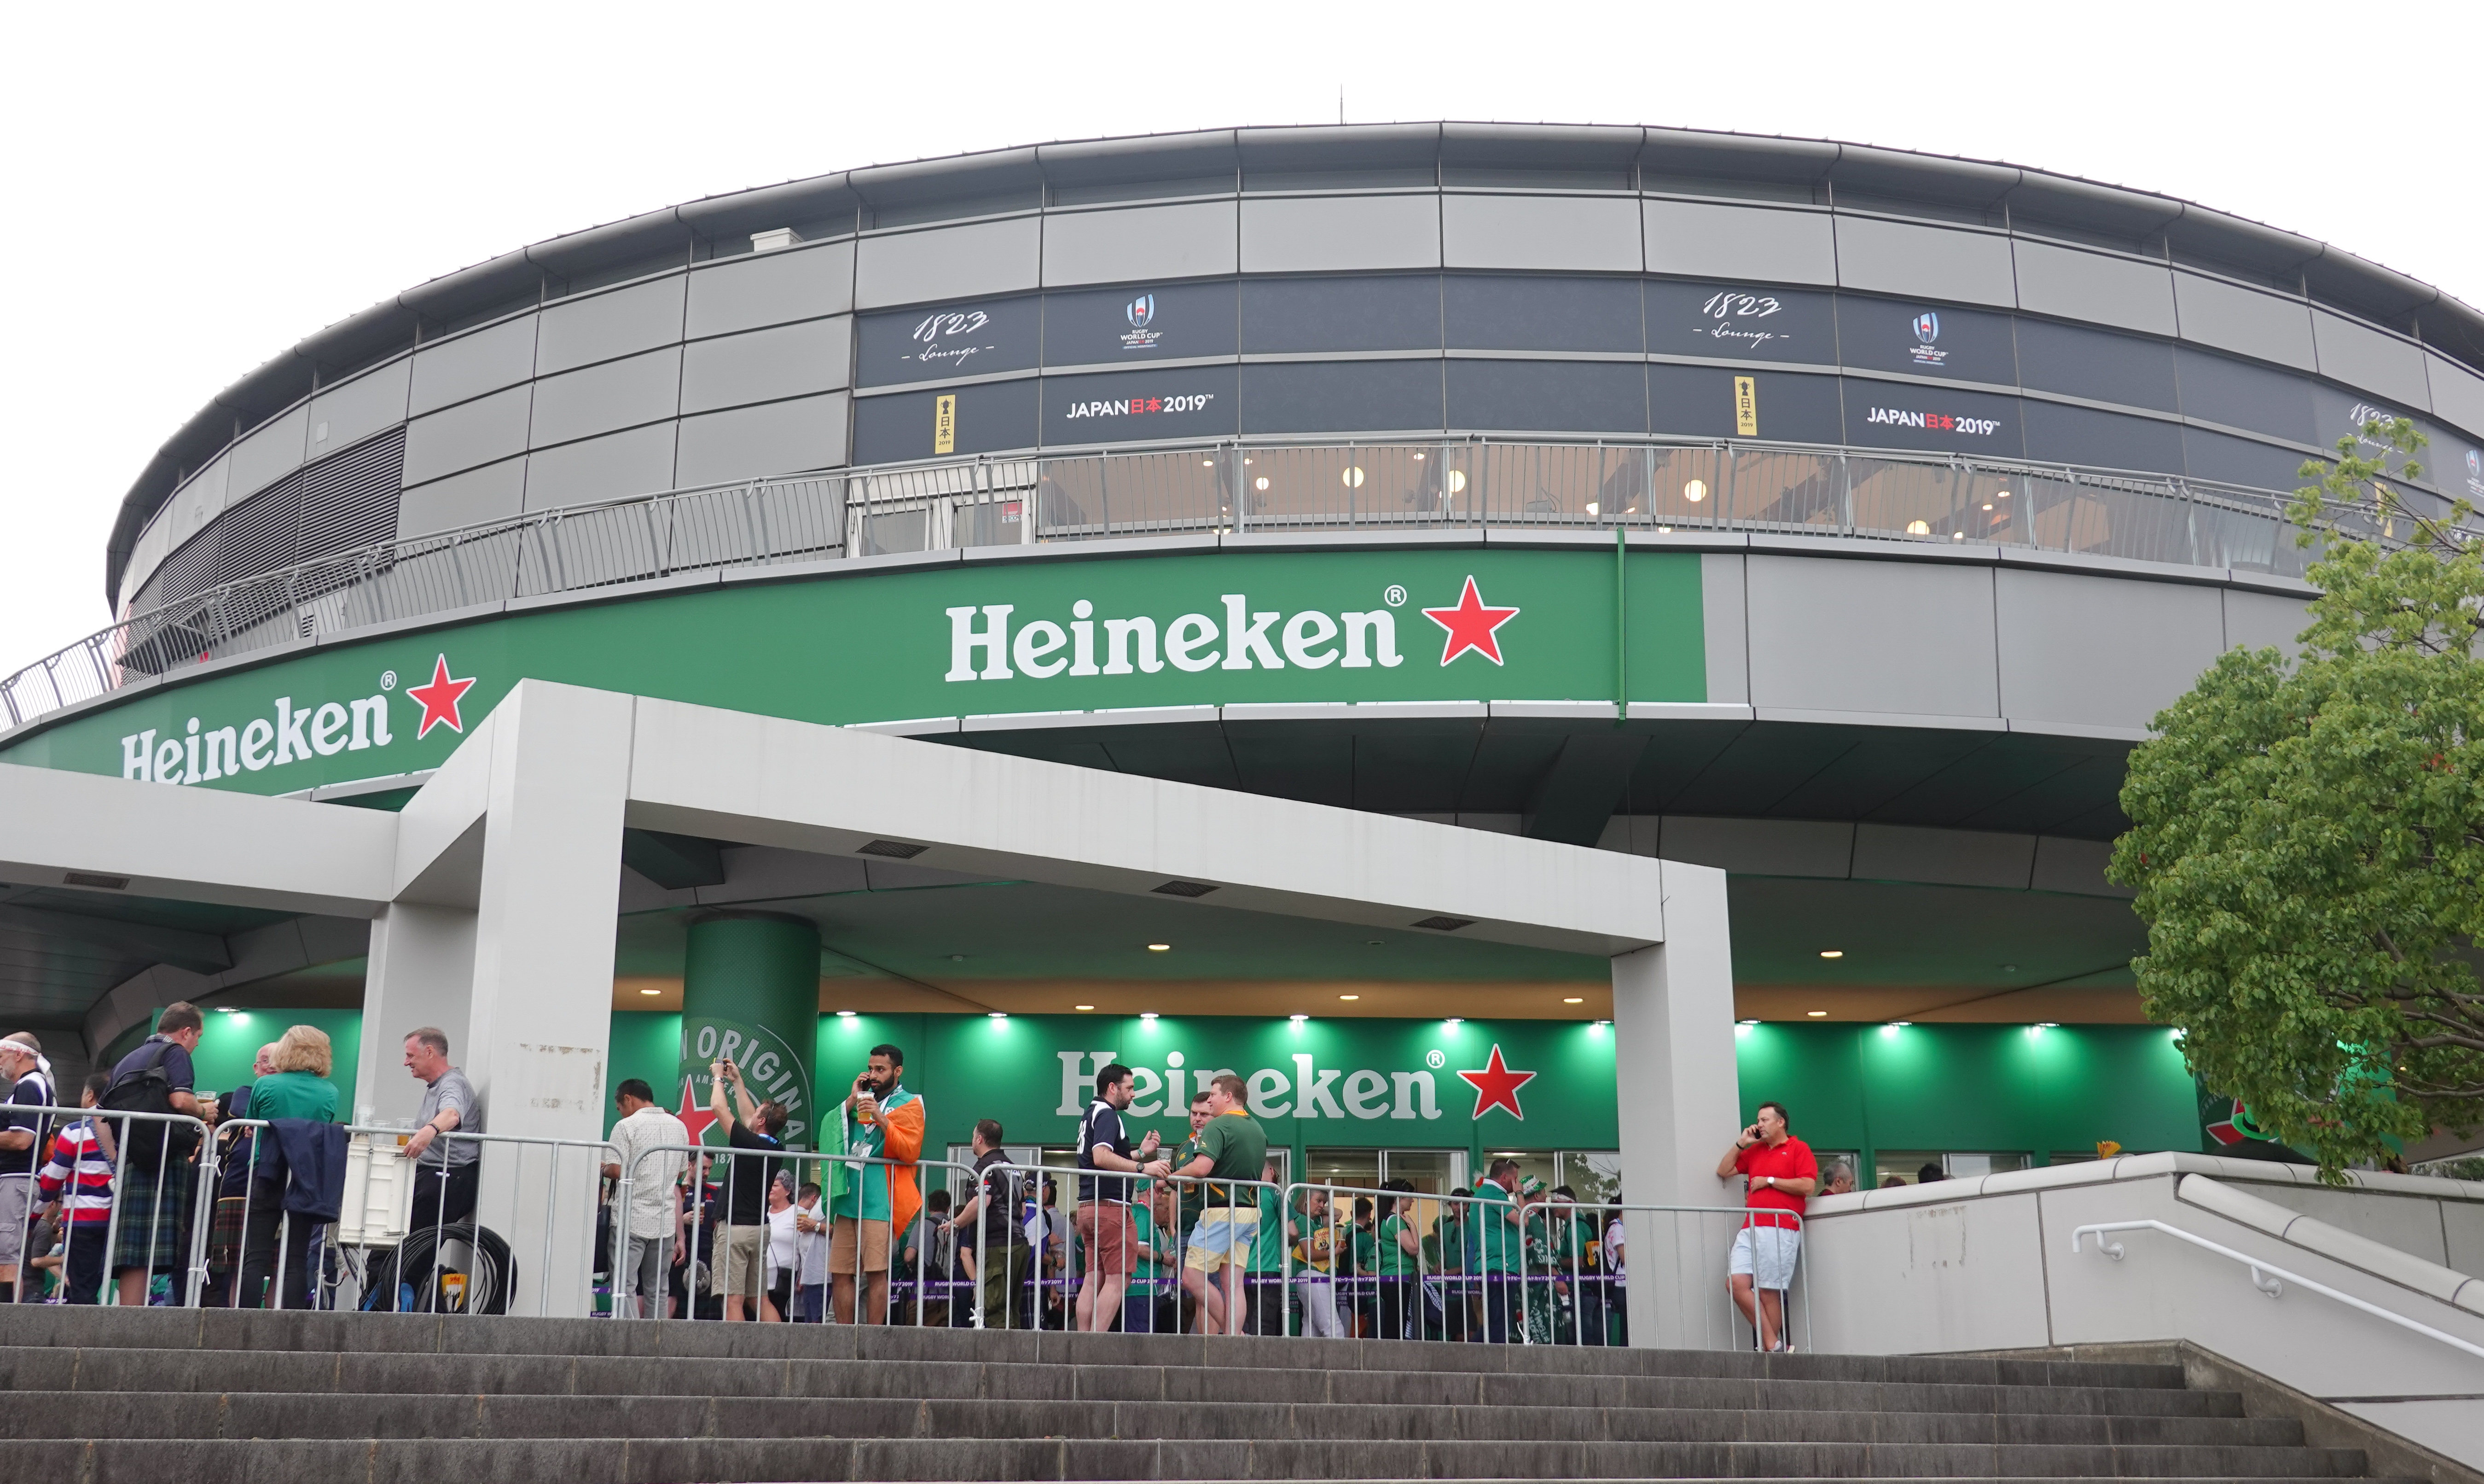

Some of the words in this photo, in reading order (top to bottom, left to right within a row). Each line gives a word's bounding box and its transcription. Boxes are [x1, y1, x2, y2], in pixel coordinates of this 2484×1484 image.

[1703, 292, 1782, 318] 1823
[913, 311, 990, 342] 1823
[1711, 322, 1774, 349] Lounge
[919, 343, 980, 366] Lounge
[1066, 399, 1129, 418] JAPAN
[1131, 397, 1162, 414] 日本
[1741, 398, 1753, 421] 日本
[1867, 407, 1925, 428] JAPAN
[1926, 413, 1955, 430] 日本
[939, 416, 951, 439] 日本
[715, 1153, 732, 1164] 187
